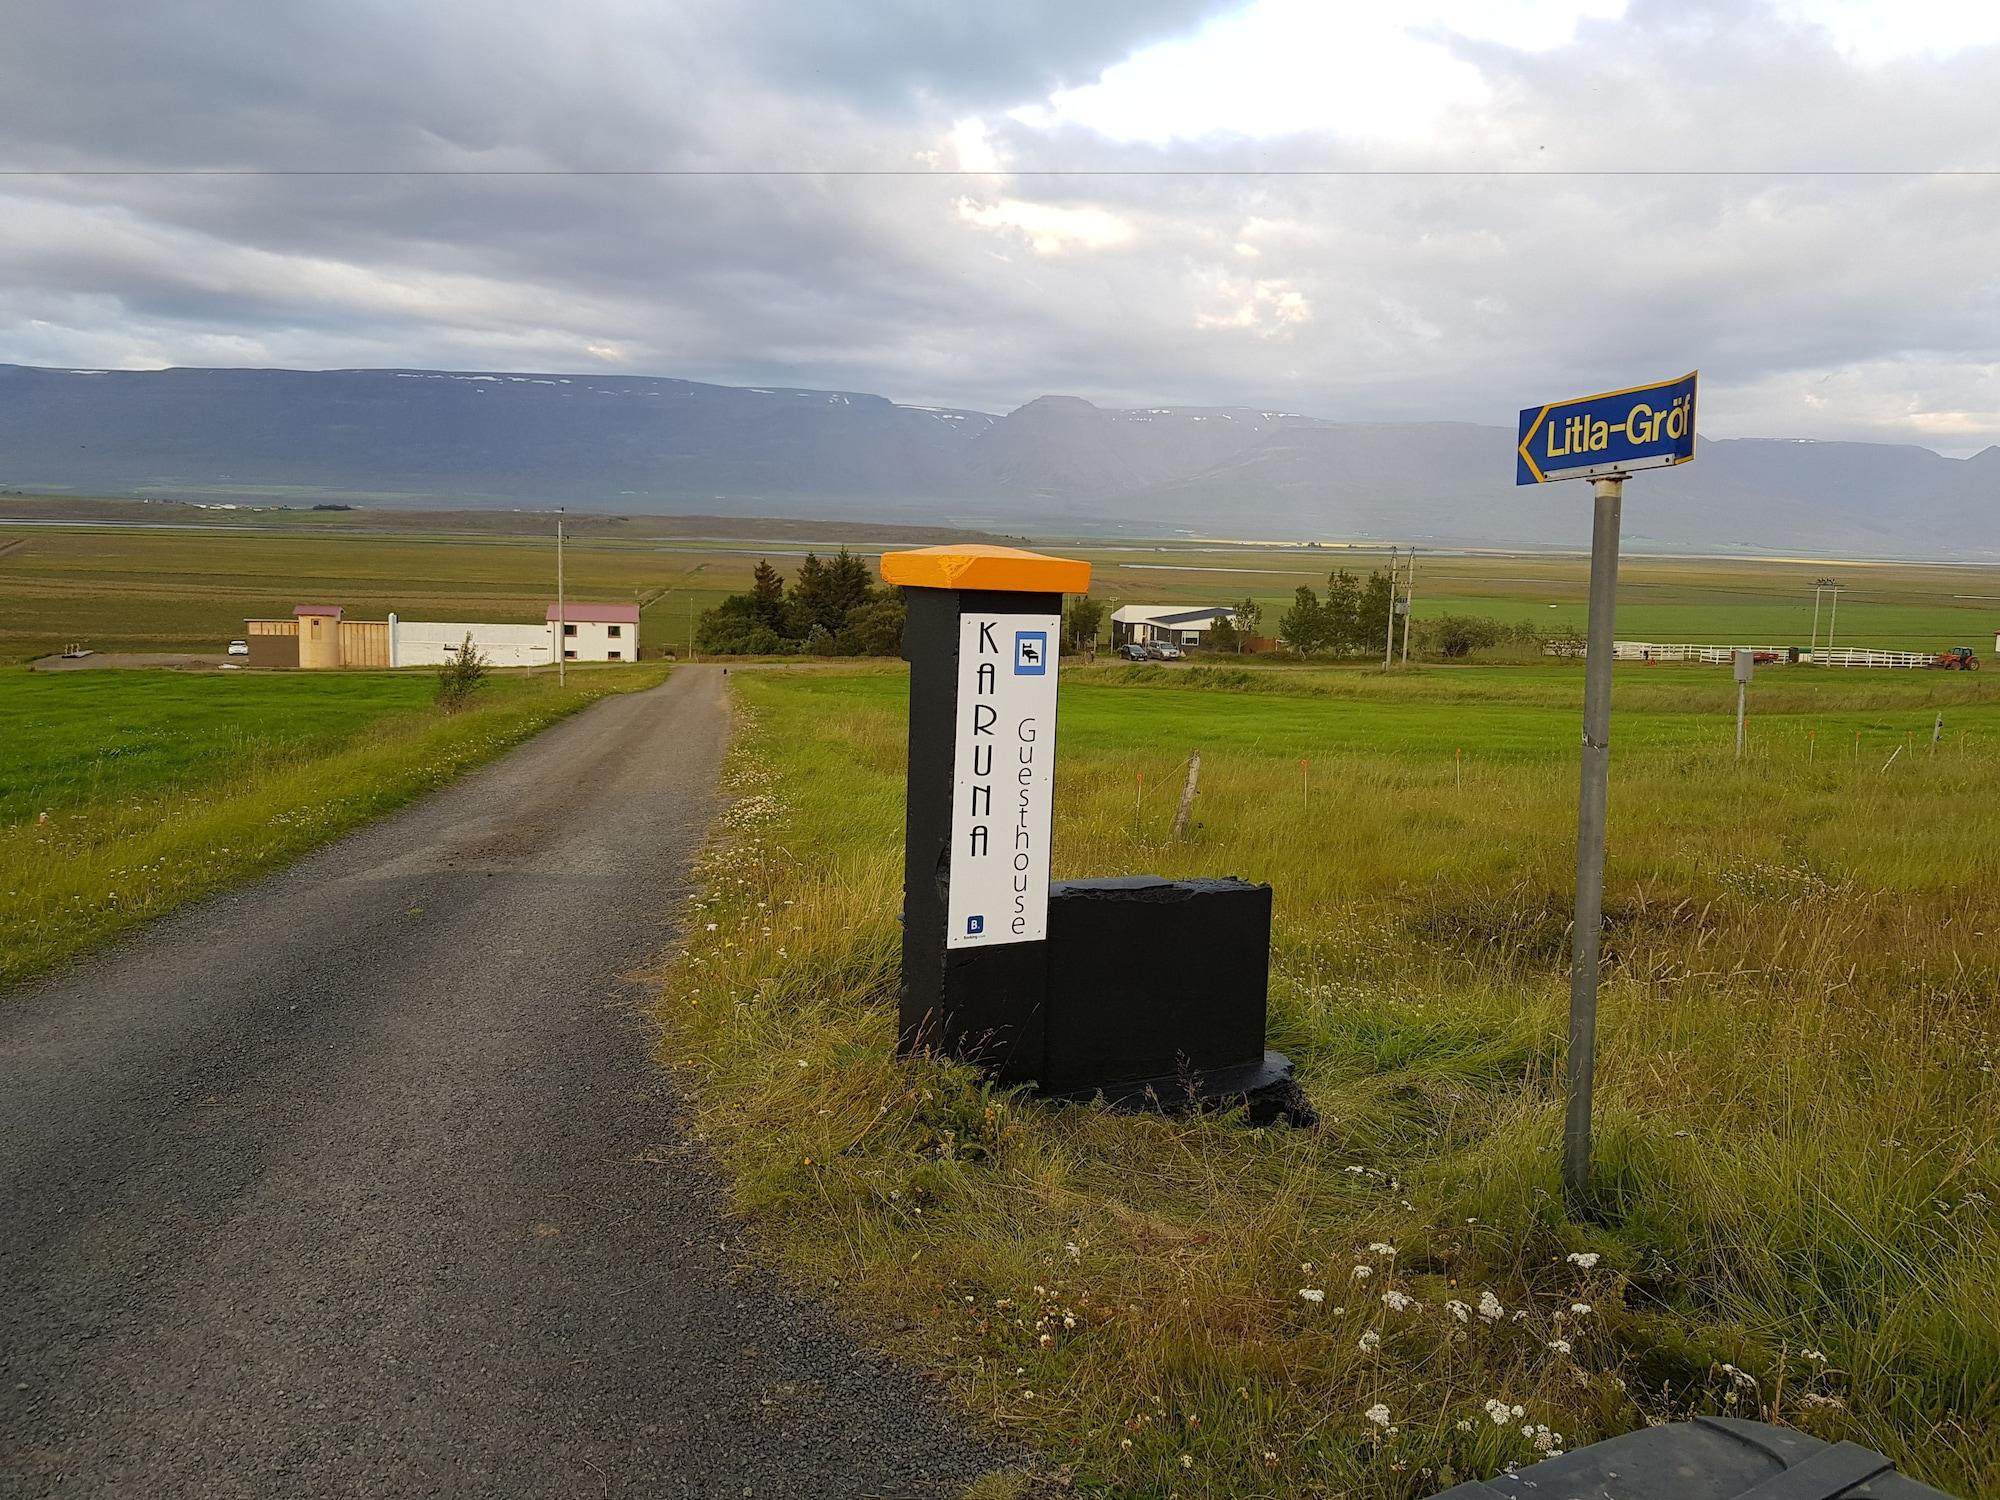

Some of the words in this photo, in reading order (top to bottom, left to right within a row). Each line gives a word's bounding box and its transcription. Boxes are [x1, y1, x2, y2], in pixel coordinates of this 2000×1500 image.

[1547, 394, 1690, 457] Litla-Gröf
[970, 622, 999, 857] KARUNA
[1012, 718, 1036, 935] Guesthouse
